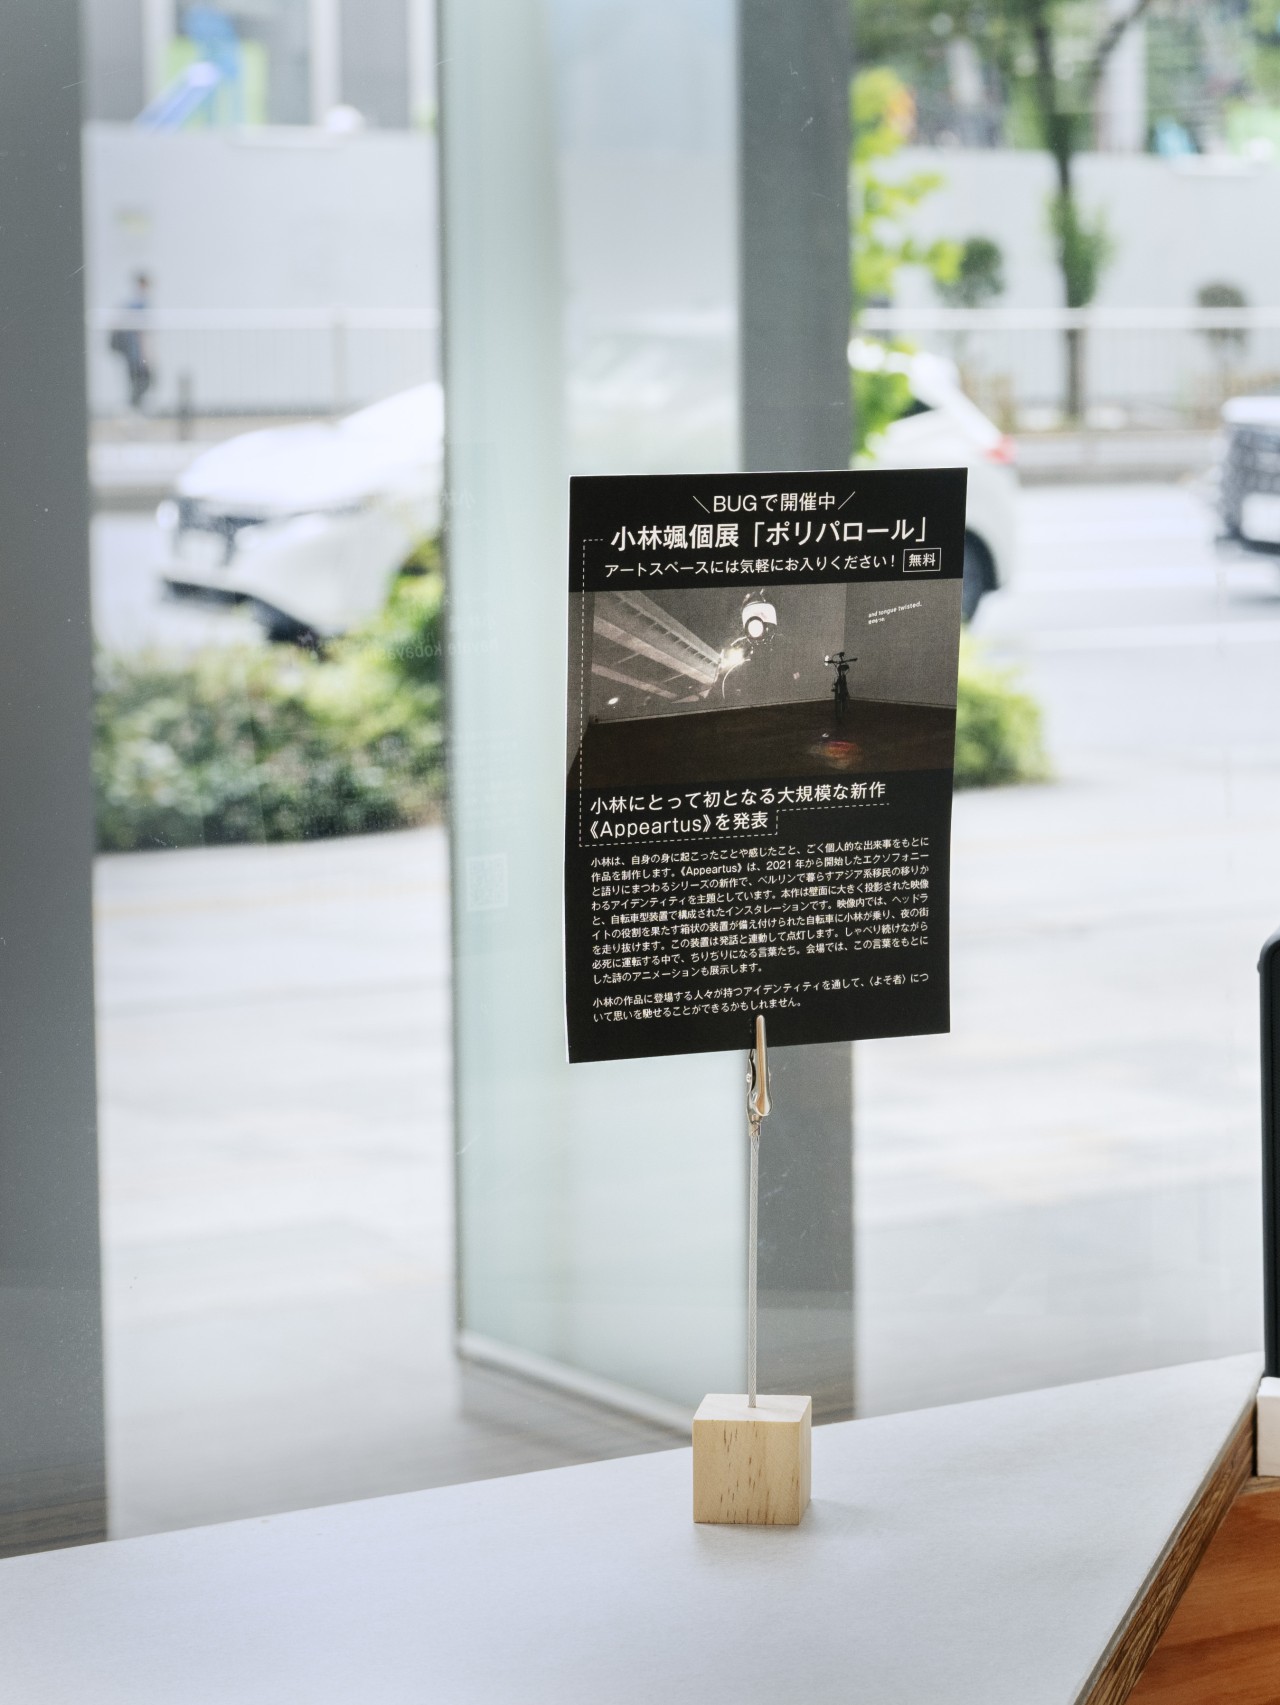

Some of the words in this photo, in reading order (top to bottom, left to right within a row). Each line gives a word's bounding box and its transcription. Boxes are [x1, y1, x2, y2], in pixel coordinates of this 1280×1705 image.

[610, 516, 927, 551] 小林颯個展「ポリパロール」
[605, 553, 895, 578] アートスペースには気軽にお入りください！
[908, 553, 936, 568] 無料
[590, 781, 886, 815] 小林にとって初となる大規模な新作
[590, 810, 769, 838] 《Appeartus》を発表
[591, 837, 929, 867] 小林は、自身の身に起こったことや感じたこと、ごく個人的な出来事をもとに
[592, 865, 929, 897] と語りにまつわるシリーズの新作で、ベルリンで暮らすアジア系移民の移りか
[592, 921, 928, 955] を走り抜けます。この装置は発話と連動して点灯します。しゃべり続けながら
[593, 963, 762, 984] した詩のアニメーションも展示します。
[593, 998, 801, 1022] いて思いを馳せることができるかもしれません。
